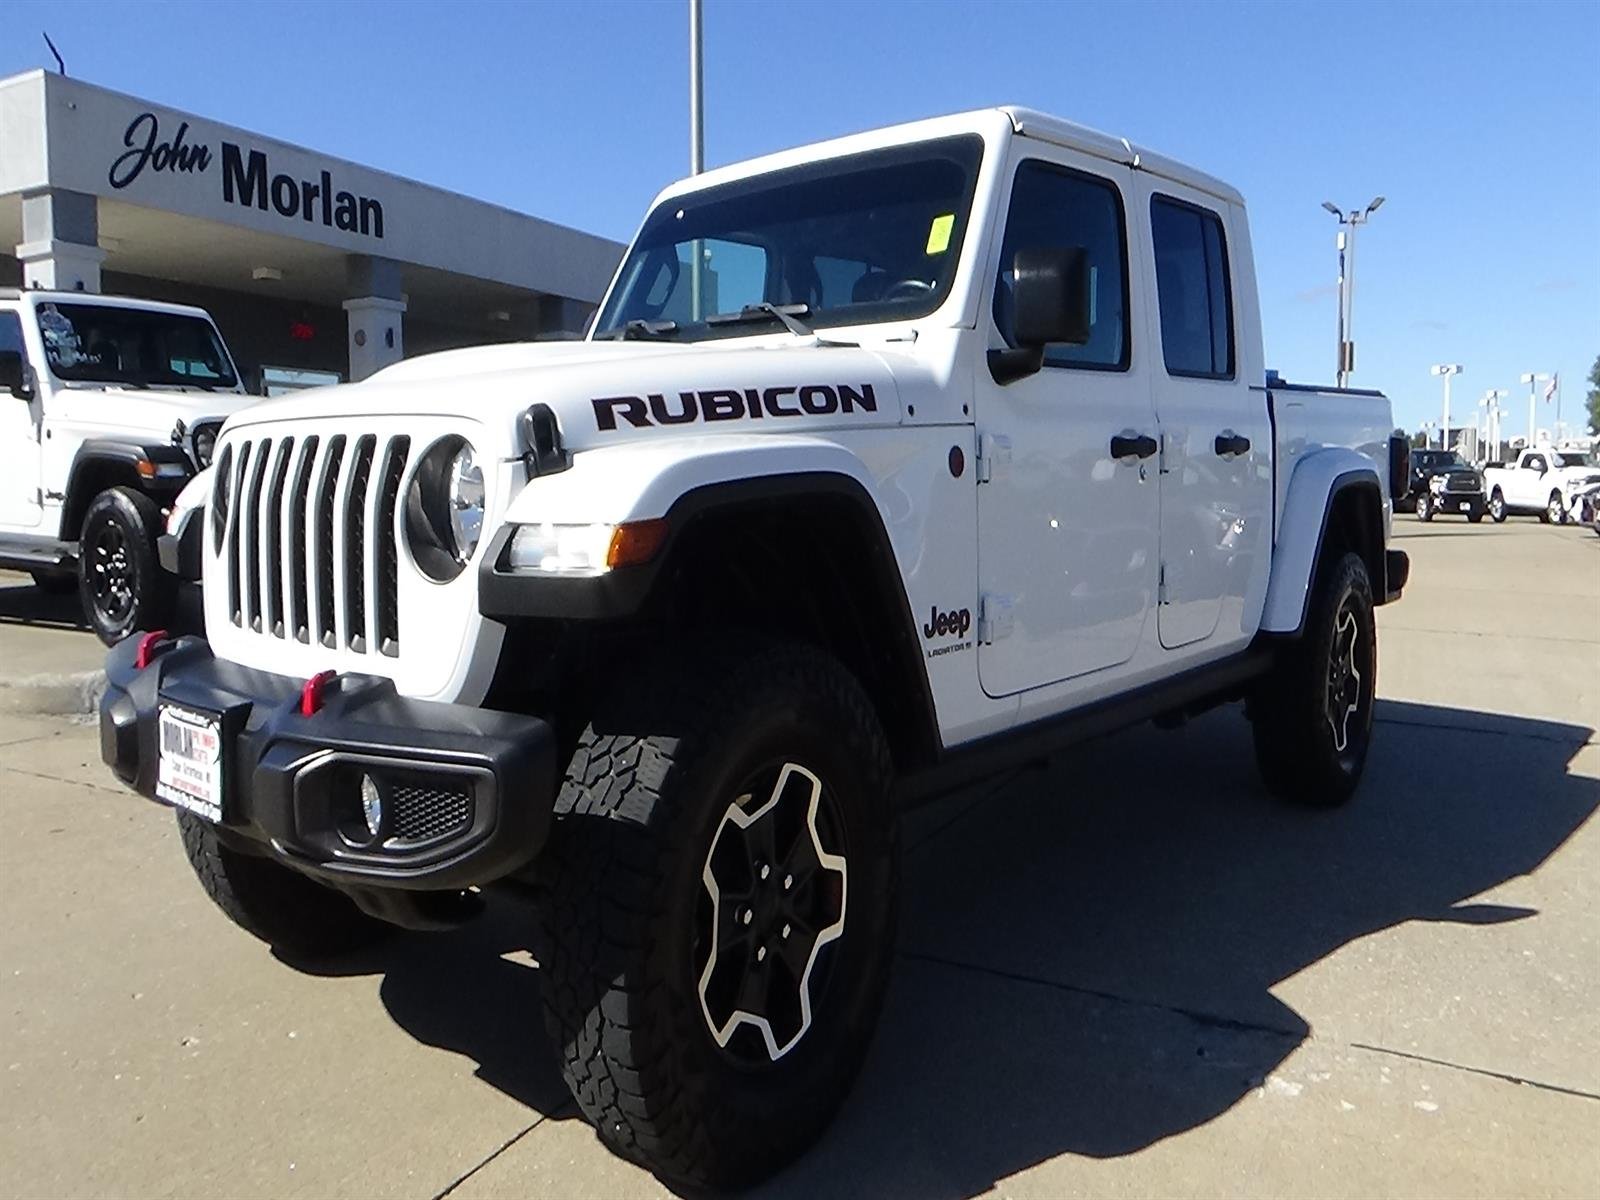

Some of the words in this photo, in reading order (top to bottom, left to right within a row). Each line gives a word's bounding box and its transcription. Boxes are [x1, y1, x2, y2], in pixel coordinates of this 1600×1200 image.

[109, 113, 212, 189] John
[221, 141, 384, 239] Morlan
[591, 384, 878, 431] RUBICON
[924, 605, 970, 639] Jeep
